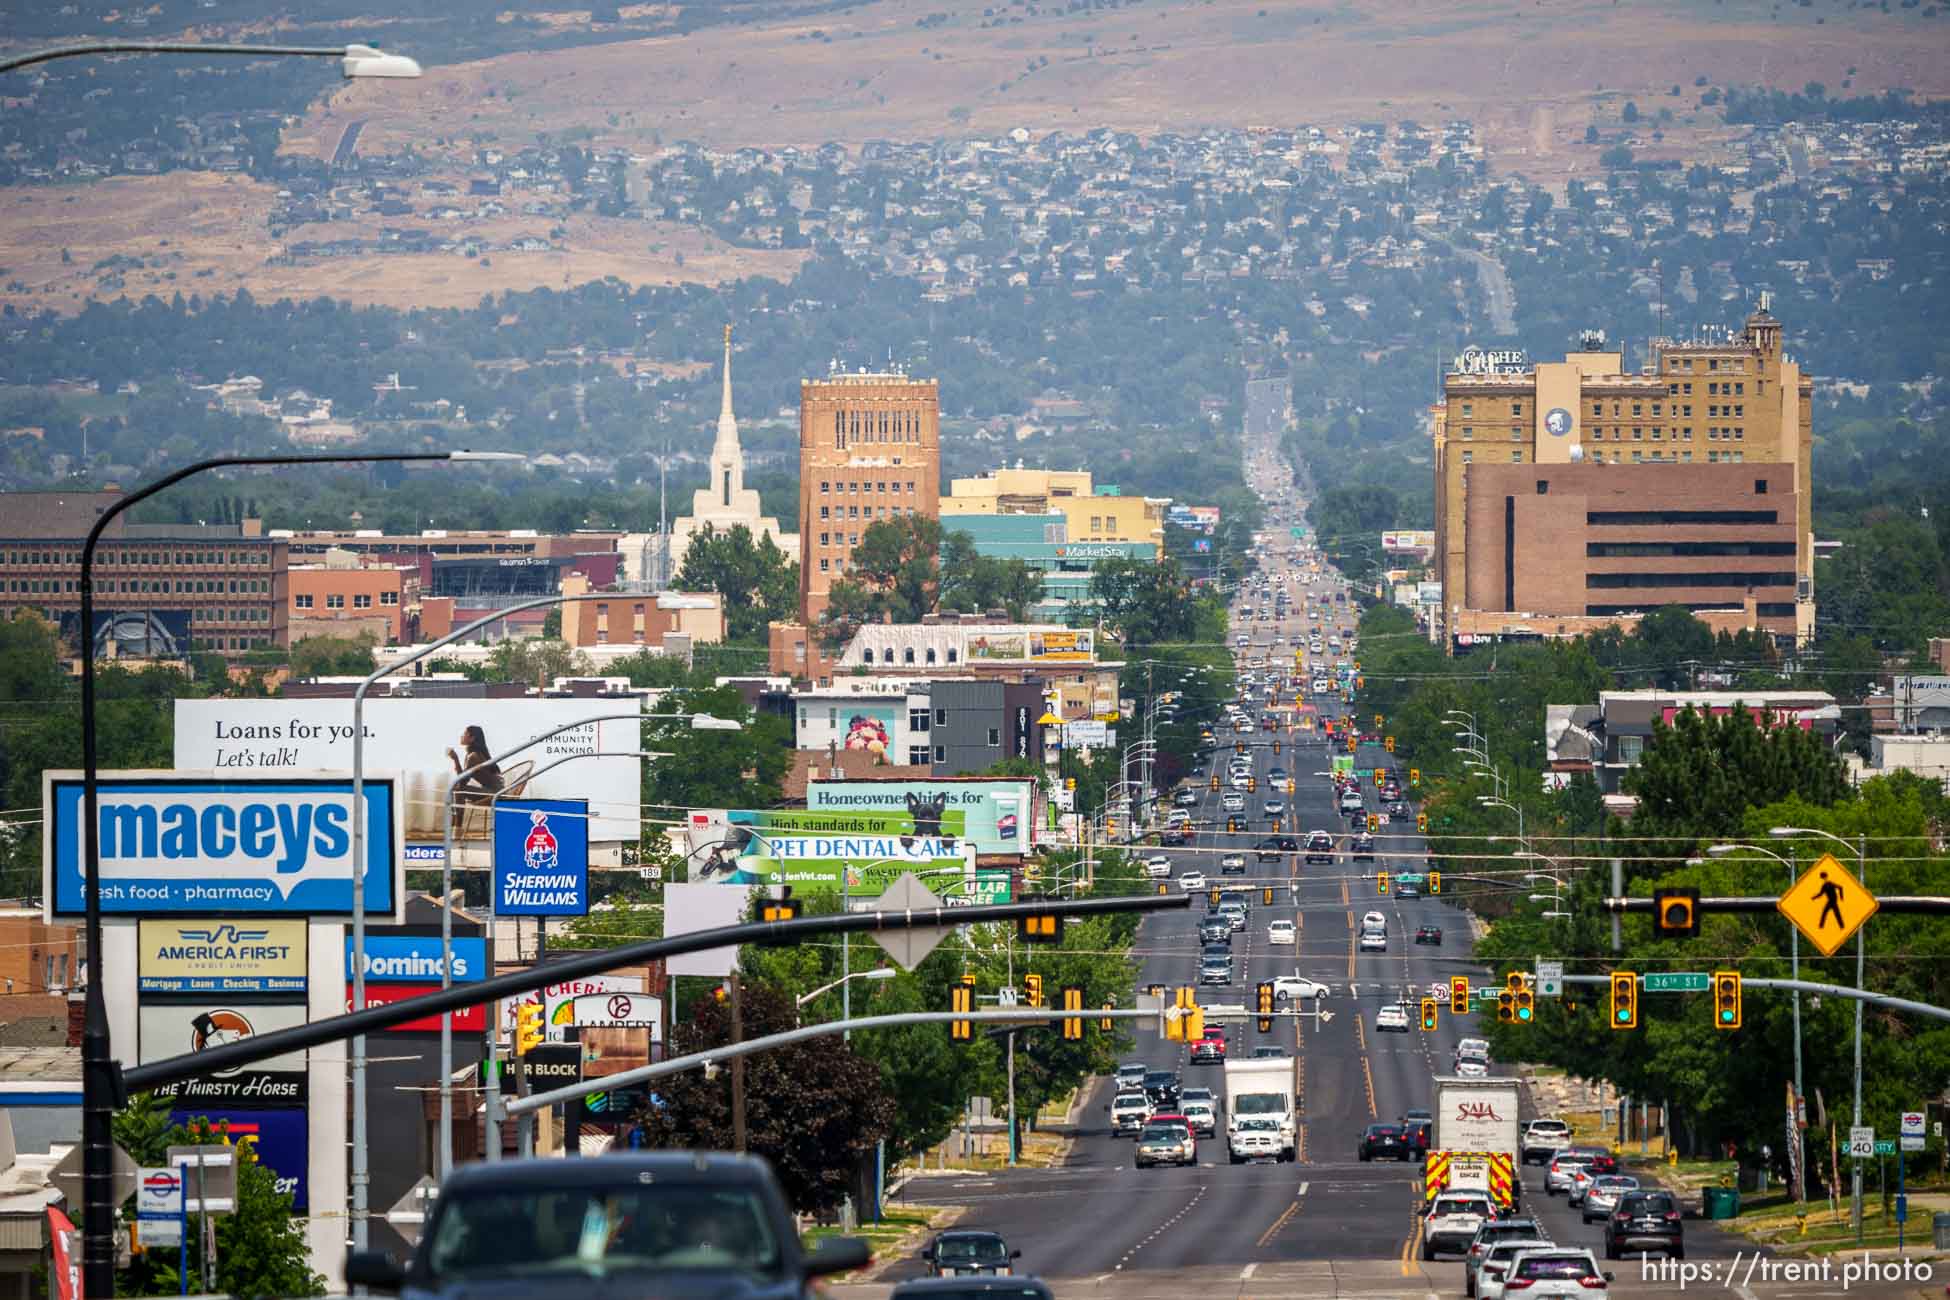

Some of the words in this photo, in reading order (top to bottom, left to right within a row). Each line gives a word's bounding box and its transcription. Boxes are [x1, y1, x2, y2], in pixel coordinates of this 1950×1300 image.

[1066, 546, 1126, 557] MarketStar
[216, 720, 281, 739] Loans
[289, 719, 321, 739] for
[328, 725, 376, 744] you.
[584, 724, 594, 732] IS
[530, 735, 593, 743] CMMUNITY
[259, 748, 298, 766] talk!
[546, 746, 594, 754] BANKING
[962, 791, 983, 804] for
[770, 819, 798, 833] High
[803, 819, 864, 831] standards
[869, 820, 886, 831] for
[99, 803, 350, 874] maceys
[770, 840, 808, 857] PET
[816, 840, 897, 857] DENTAL
[504, 872, 577, 889] SHERWIN
[80, 885, 125, 900] fesh
[129, 884, 169, 900] food
[185, 885, 273, 902] pharmacy
[157, 946, 236, 960] AMERICA
[239, 946, 290, 960] FIRST
[1685, 977, 1698, 987] ST
[506, 1064, 533, 1076] HR
[536, 1064, 577, 1076] BLOCK
[182, 1078, 241, 1096] THIRSTY
[242, 1075, 299, 1096] HORSE
[1456, 1102, 1503, 1122] SAIA
[1853, 1143, 1872, 1154] 40
